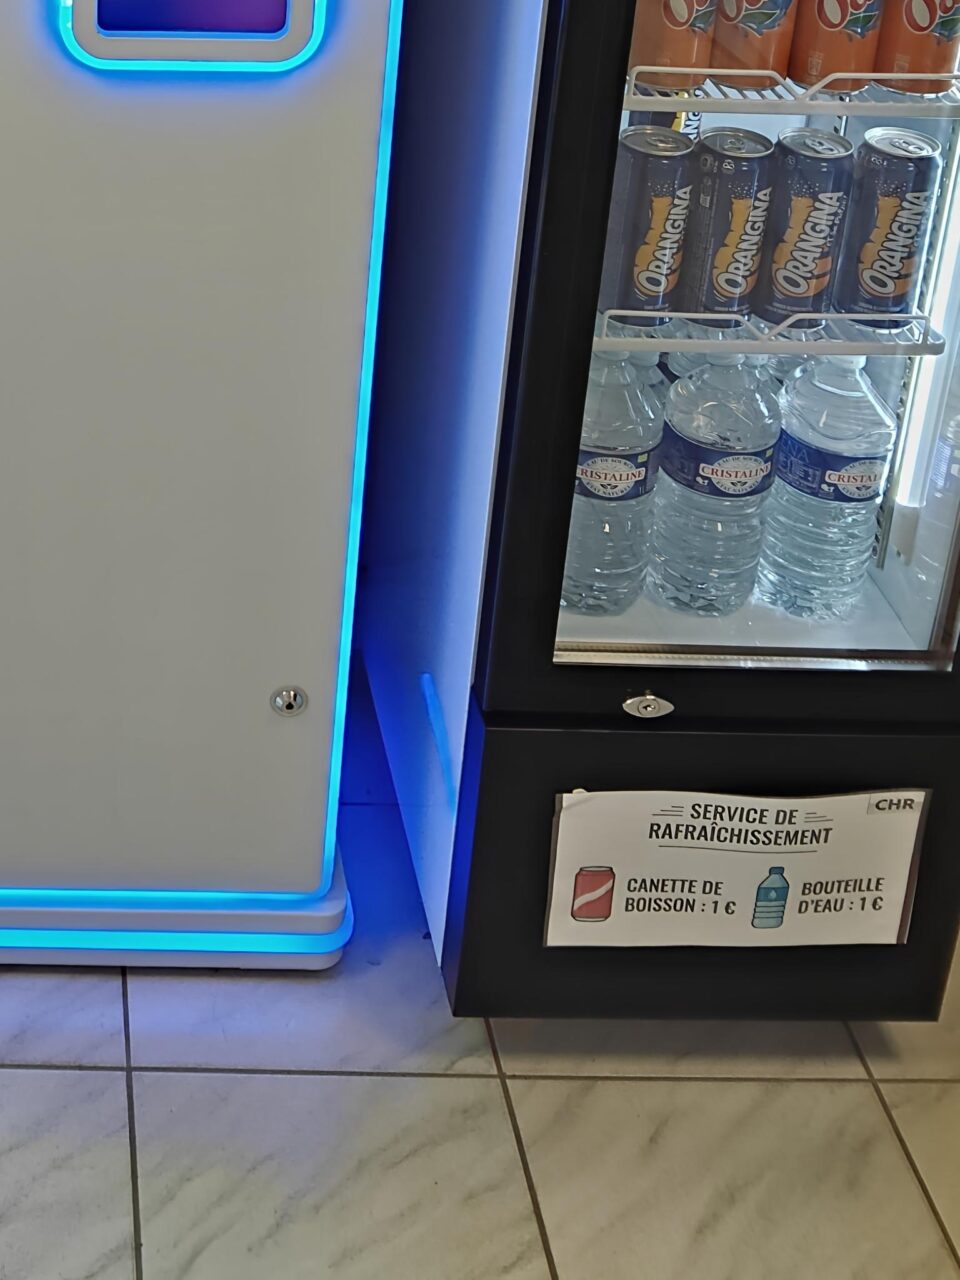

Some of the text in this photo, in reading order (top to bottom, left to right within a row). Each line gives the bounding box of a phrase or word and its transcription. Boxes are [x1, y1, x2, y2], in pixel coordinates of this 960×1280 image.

[637, 185, 693, 295] ORANGINA
[716, 186, 773, 294] ORANGINA
[775, 191, 844, 294] ORANGINA
[860, 191, 931, 294] ORANGINA
[701, 464, 770, 478] CRISTALINE
[690, 803, 799, 825] SERVICE DE
[874, 798, 915, 812] CHR
[648, 822, 833, 846] RAFRAÎCHISSEMENT
[626, 878, 724, 896] CANETTE DE
[801, 877, 885, 897] BOUTEILLE
[624, 897, 695, 913] BOISSON
[712, 900, 719, 913] 1
[724, 900, 737, 915] €
[798, 899, 845, 915] D'EAU
[859, 896, 867, 911] 1
[870, 895, 883, 911] €
